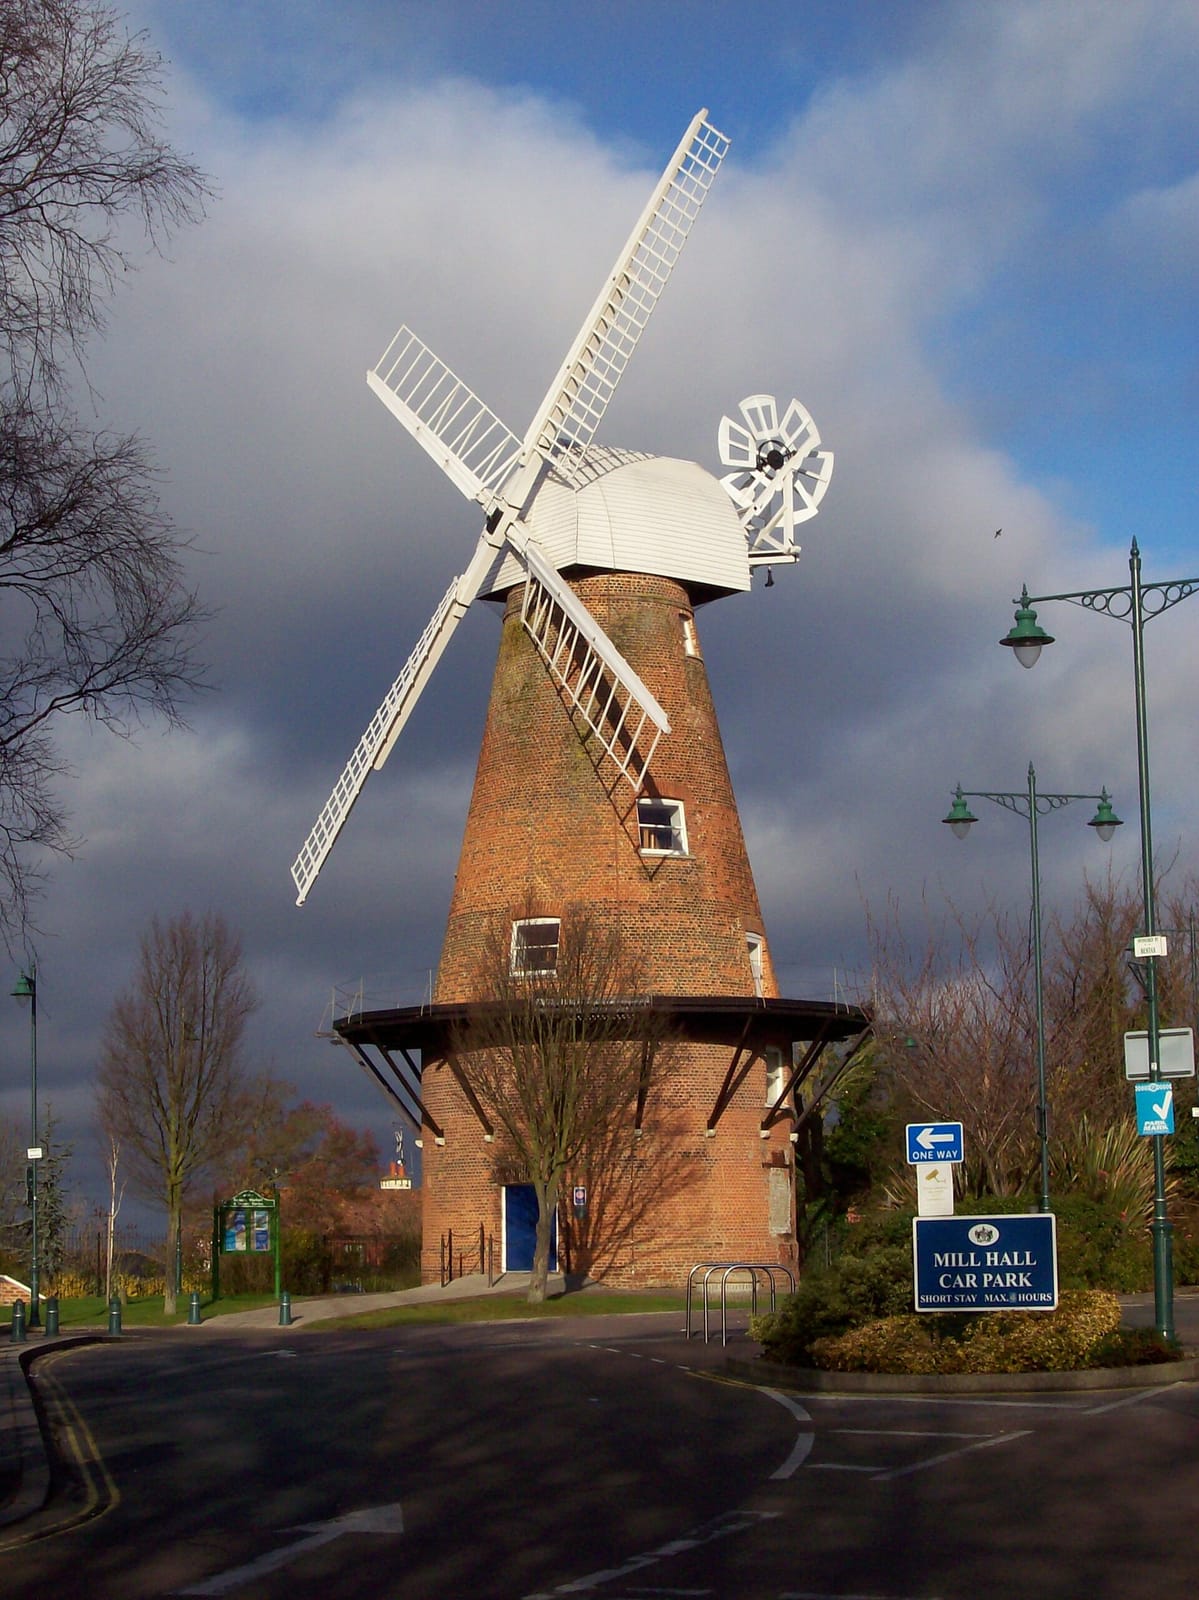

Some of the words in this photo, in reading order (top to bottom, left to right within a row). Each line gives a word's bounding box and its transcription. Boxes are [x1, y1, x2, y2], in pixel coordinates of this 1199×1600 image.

[912, 1151, 934, 1160] ONE
[936, 1150, 958, 1159] WAY
[934, 1252, 981, 1267] MILL
[985, 1250, 1037, 1266] HALL
[939, 1273, 978, 1288] CAR
[982, 1272, 1033, 1287] PARK
[920, 1294, 952, 1303] SHORT
[954, 1294, 978, 1303] STAY
[984, 1293, 1009, 1303] MAX.
[1018, 1292, 1053, 1302] HOURS
